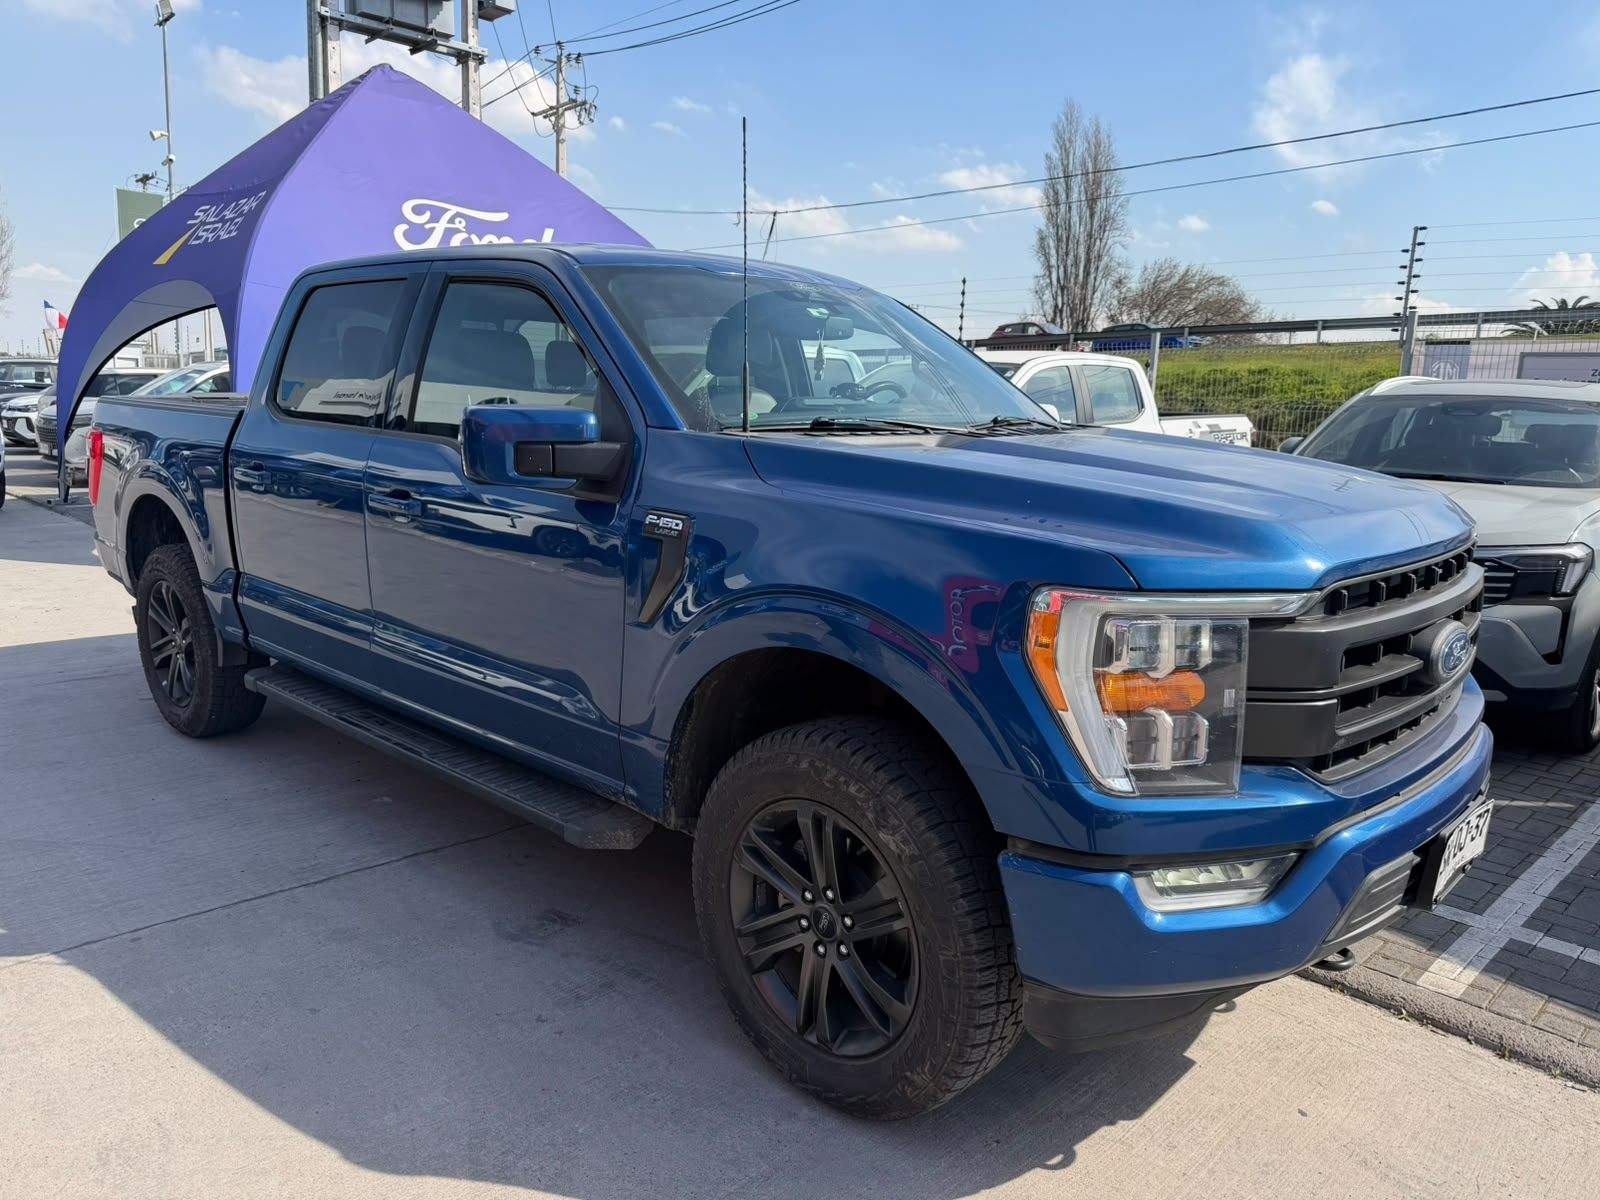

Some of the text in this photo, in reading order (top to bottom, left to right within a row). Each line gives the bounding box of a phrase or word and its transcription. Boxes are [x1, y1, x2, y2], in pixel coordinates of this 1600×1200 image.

[187, 191, 266, 224] SALAZAR
[188, 217, 244, 245] ISRAEL
[645, 514, 683, 530] F-150
